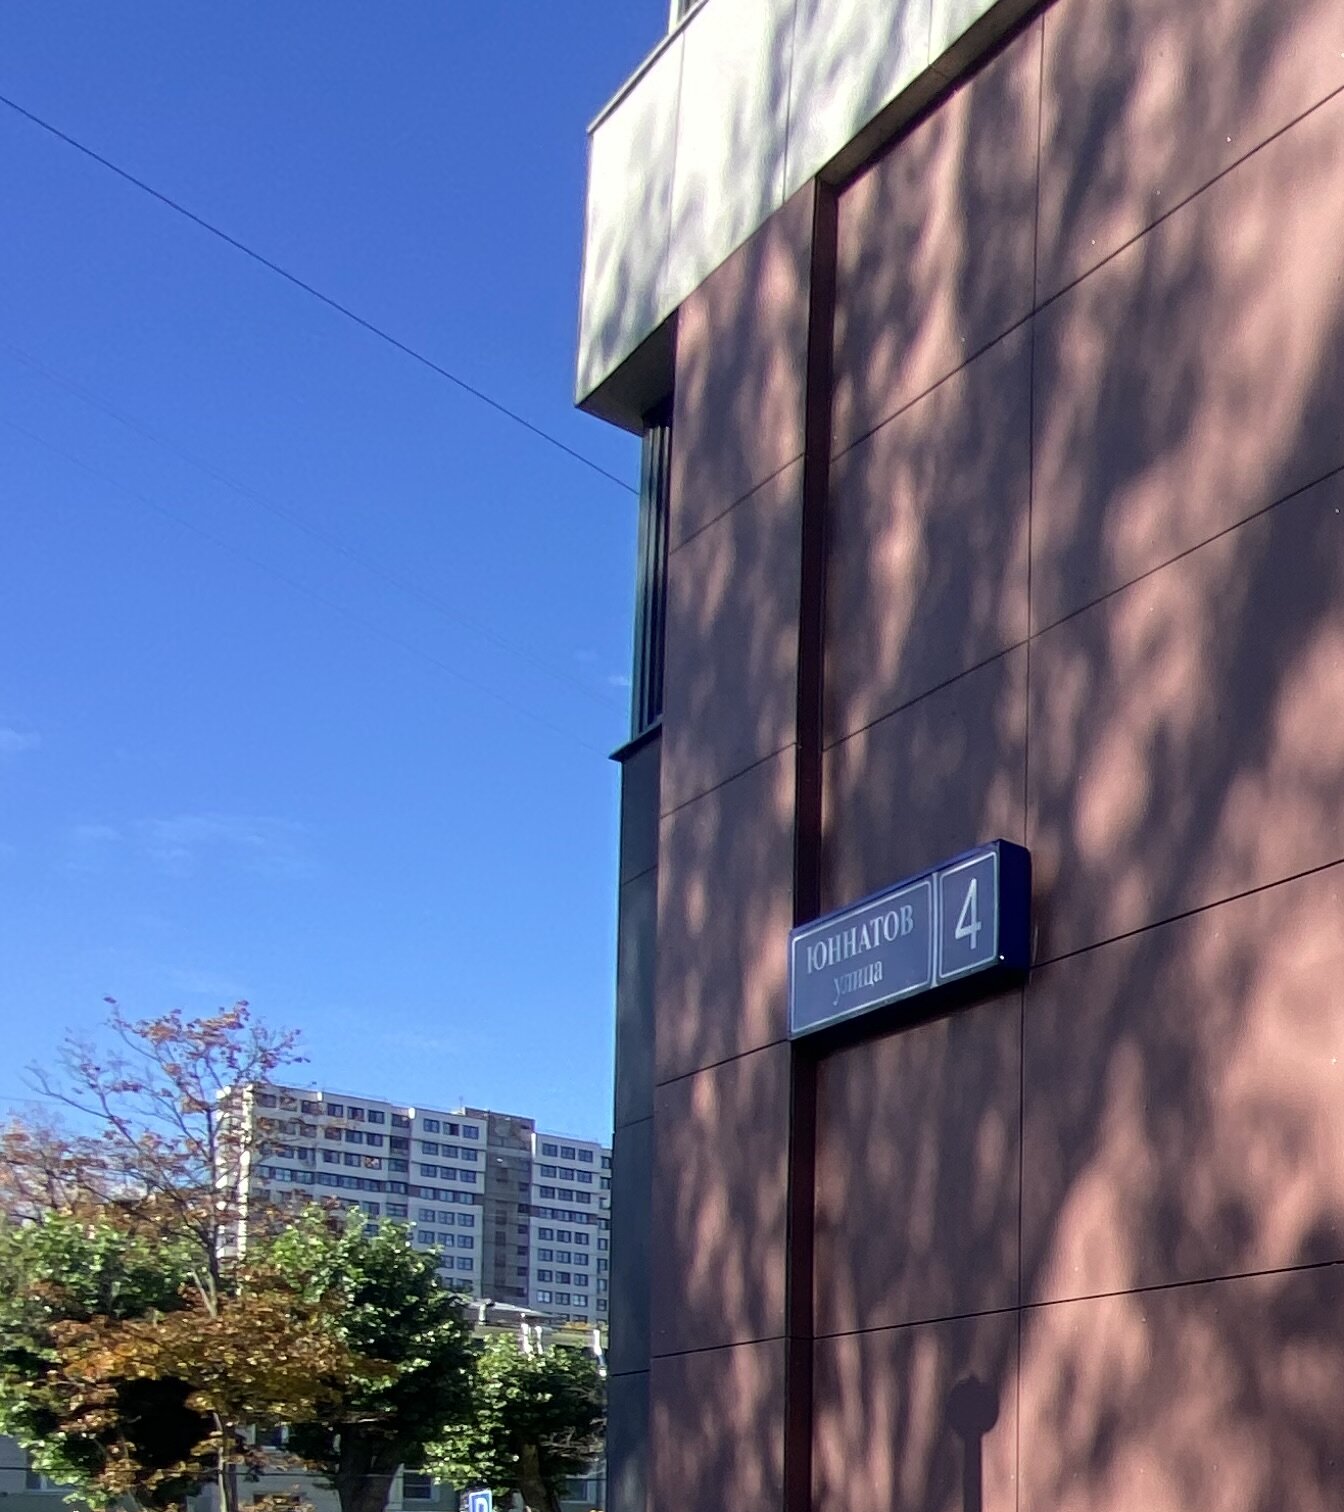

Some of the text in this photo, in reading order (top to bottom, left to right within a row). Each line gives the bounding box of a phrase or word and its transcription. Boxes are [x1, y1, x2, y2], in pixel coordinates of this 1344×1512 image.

[807, 904, 914, 974] ЮННАТОВ
[955, 878, 981, 949] 4
[833, 960, 883, 1006] улица
